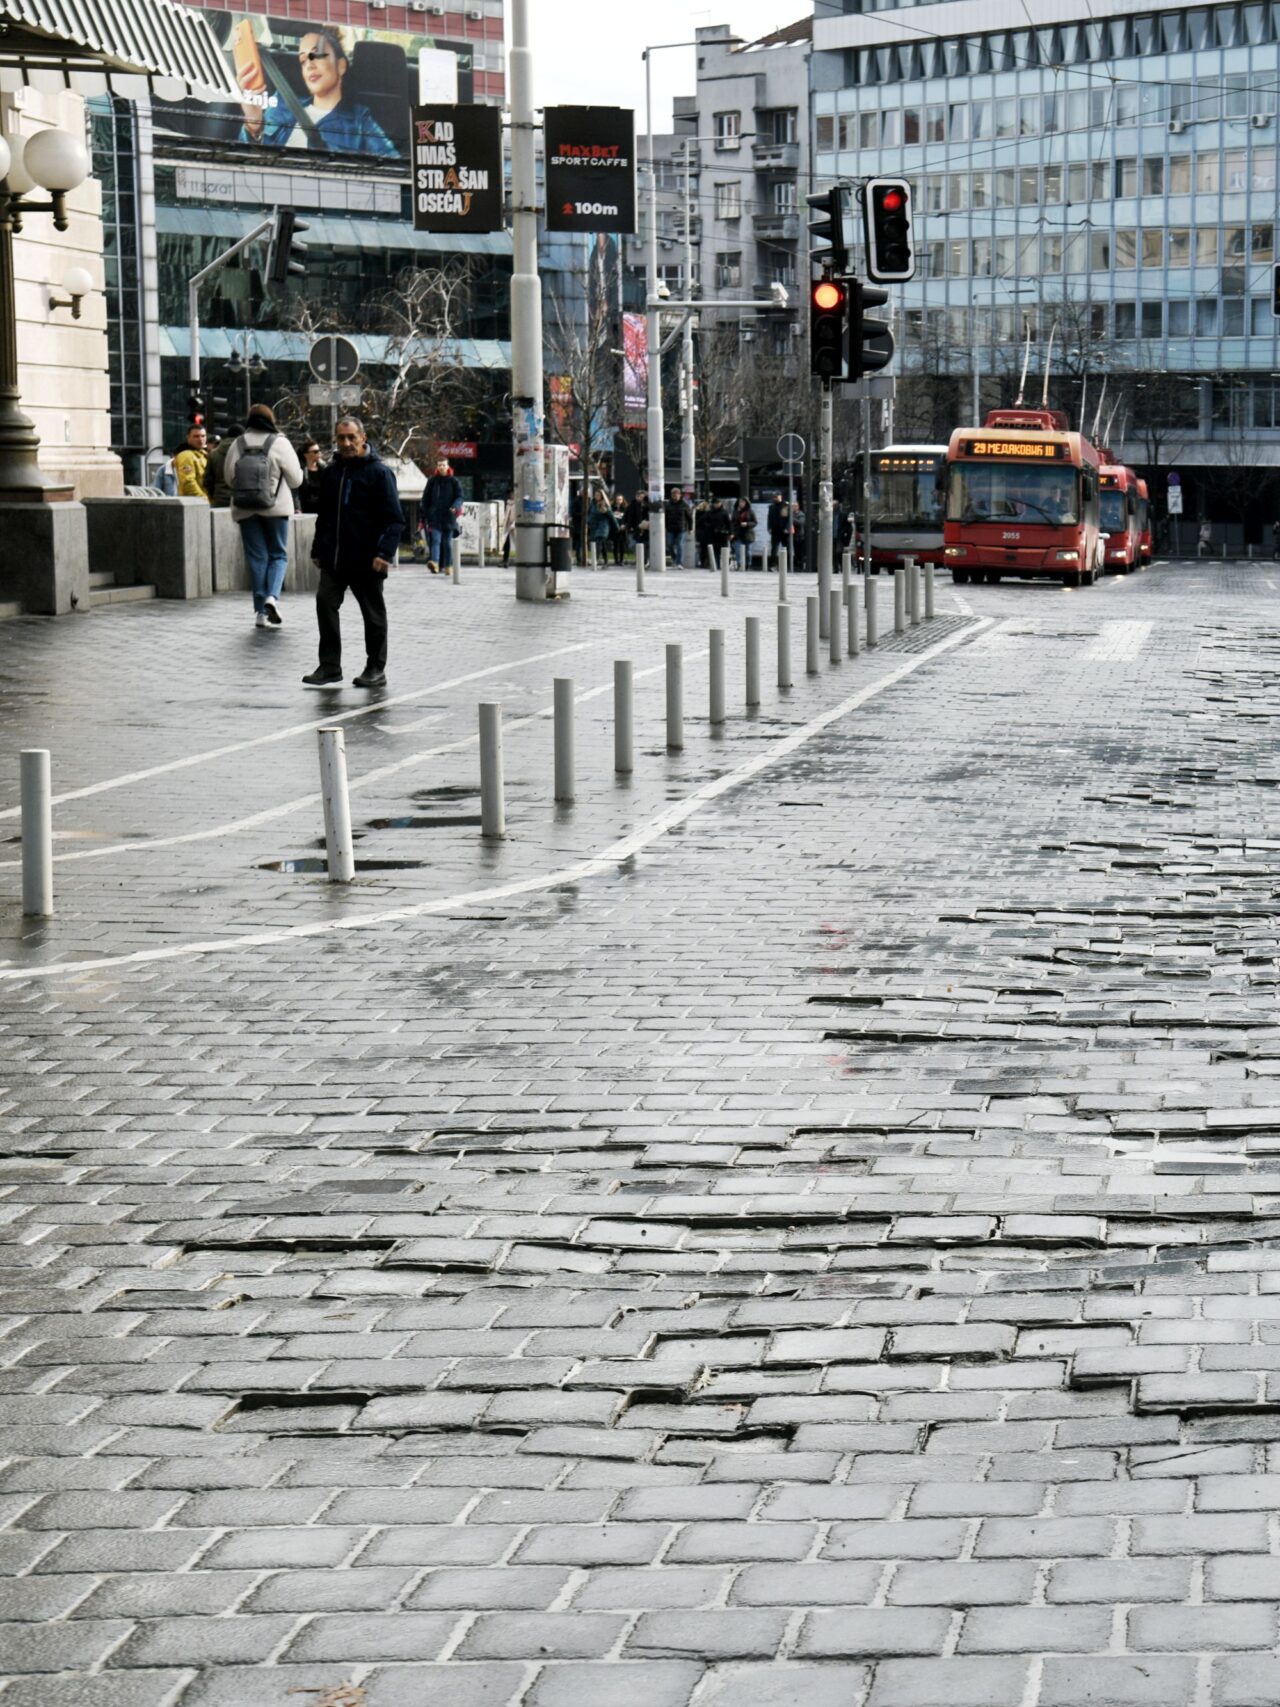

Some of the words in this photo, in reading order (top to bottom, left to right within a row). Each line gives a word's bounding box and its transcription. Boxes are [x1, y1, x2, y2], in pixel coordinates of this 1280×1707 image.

[415, 120, 454, 143] KAD
[417, 142, 456, 165] IMAŠ
[551, 156, 589, 165] SPORT
[590, 158, 628, 167] CAFFE
[417, 166, 488, 190] STRAŠAN
[418, 190, 474, 215] OSEĆAJ
[575, 202, 618, 215] 100m
[973, 442, 987, 454] 29
